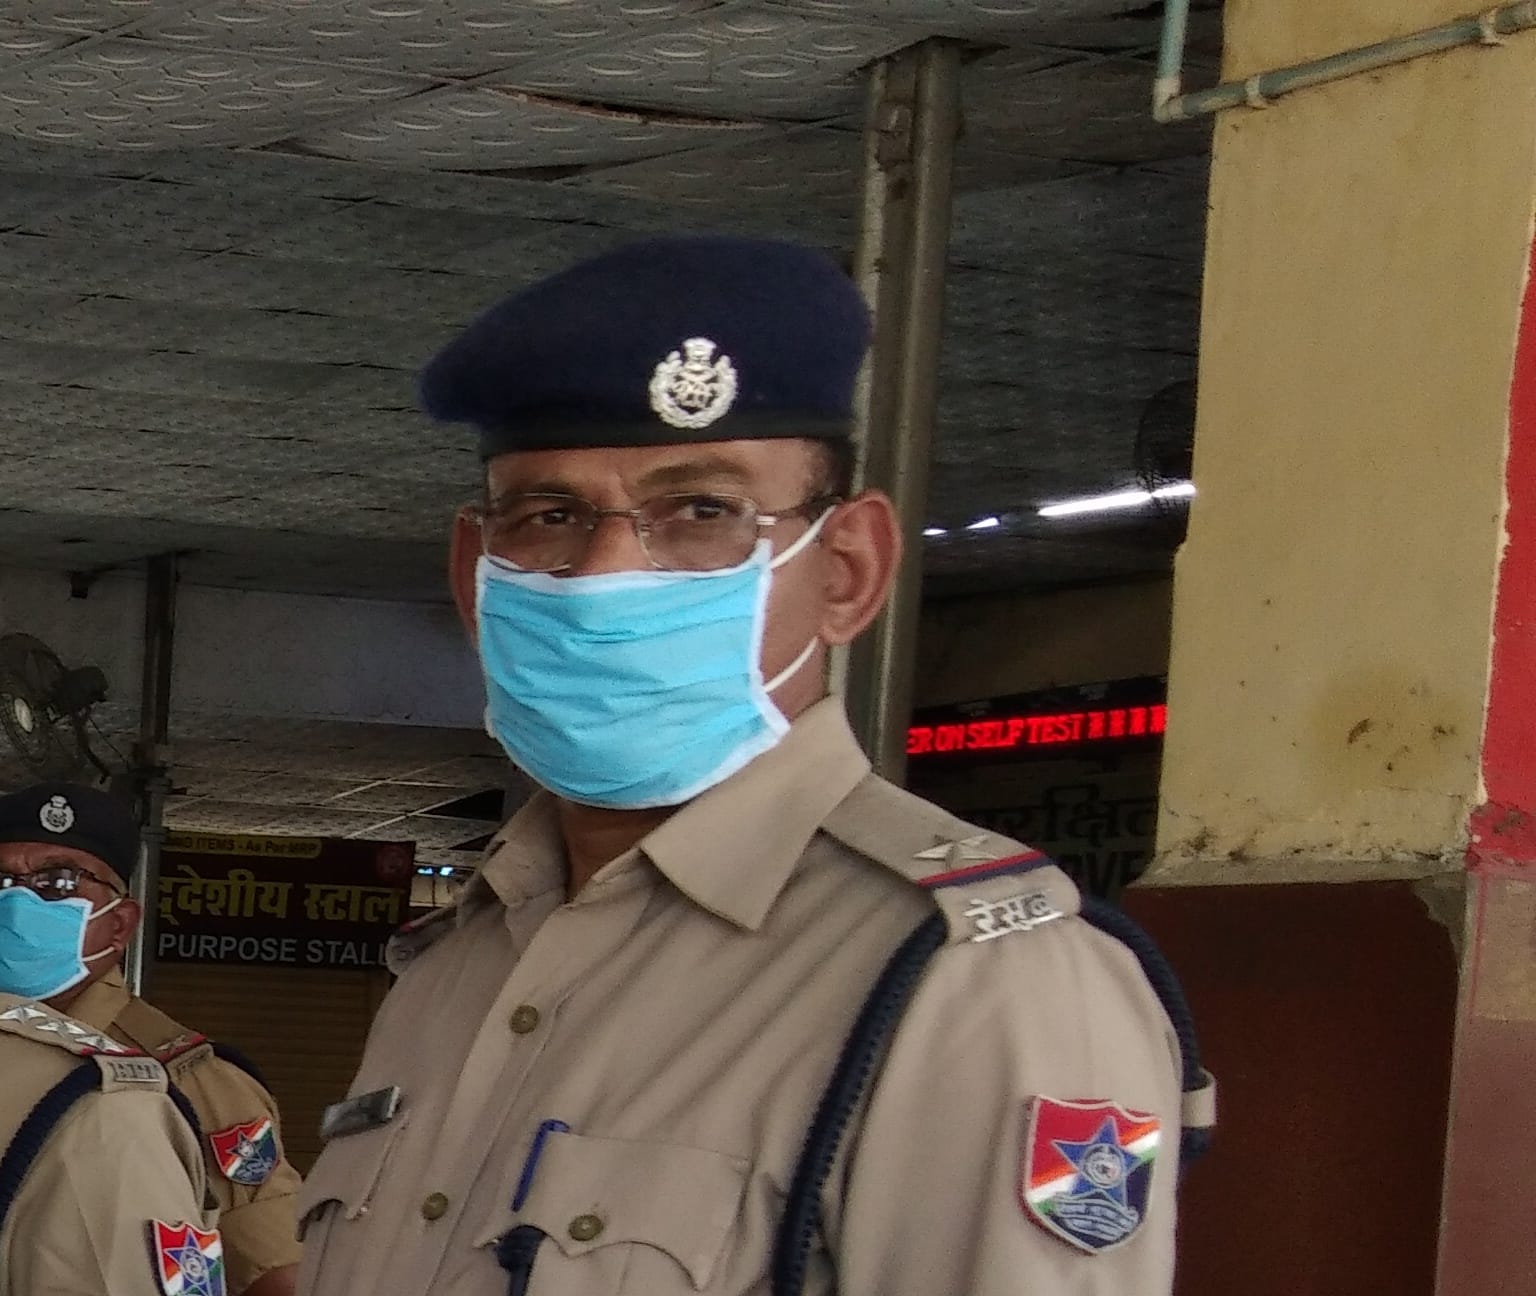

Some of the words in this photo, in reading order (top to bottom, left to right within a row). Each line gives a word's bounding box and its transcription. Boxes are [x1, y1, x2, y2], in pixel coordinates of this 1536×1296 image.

[935, 724, 966, 752] ON
[966, 718, 1024, 749] SELF
[1026, 713, 1085, 743] TEST
[304, 883, 405, 924] स्टाल
[158, 933, 297, 962] PURPOSE
[306, 939, 387, 966] STALL
